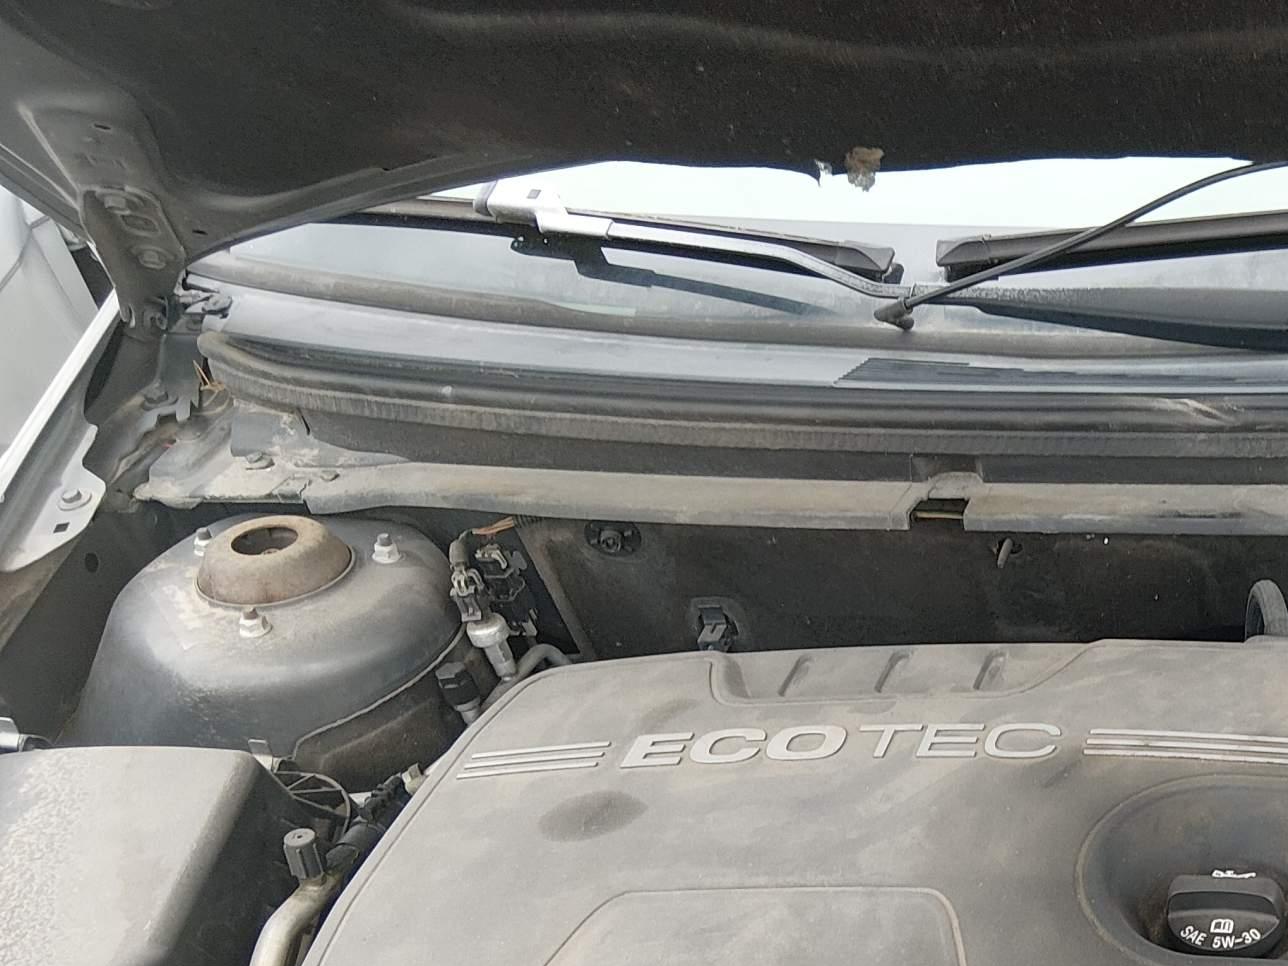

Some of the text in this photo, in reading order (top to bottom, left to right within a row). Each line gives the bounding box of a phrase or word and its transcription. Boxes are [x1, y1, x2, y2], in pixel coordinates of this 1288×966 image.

[620, 724, 1063, 769] ECOTEC
[1180, 925, 1261, 949] SAE 5W-30
